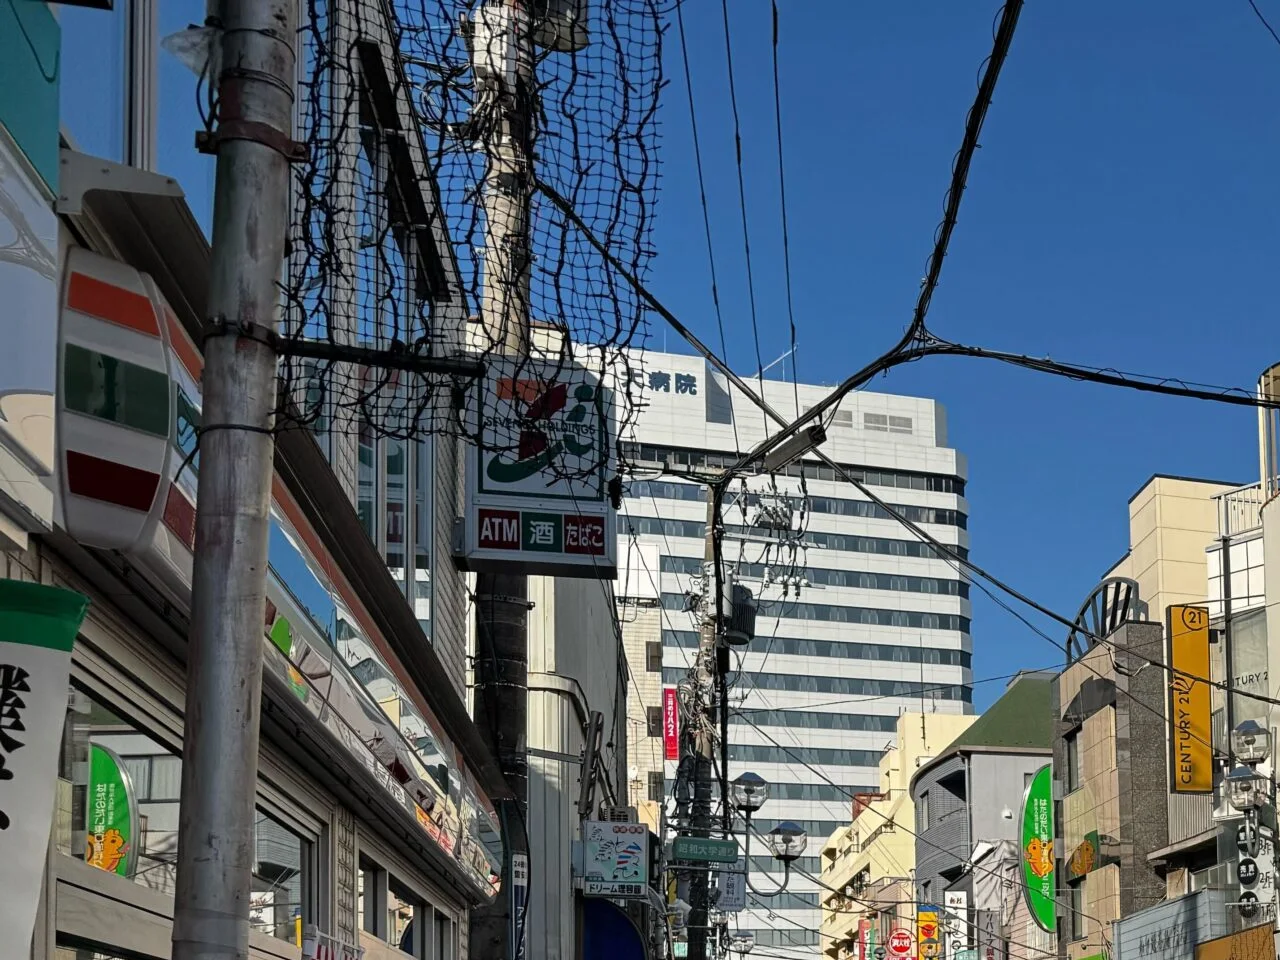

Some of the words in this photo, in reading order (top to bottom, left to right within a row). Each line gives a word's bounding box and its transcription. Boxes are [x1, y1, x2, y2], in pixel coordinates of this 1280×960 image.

[480, 517, 518, 543] ATM
[529, 520, 555, 545] 酒
[566, 522, 603, 547] たばこ
[1188, 612, 1202, 625] 21
[1179, 710, 1192, 784] CENTURY
